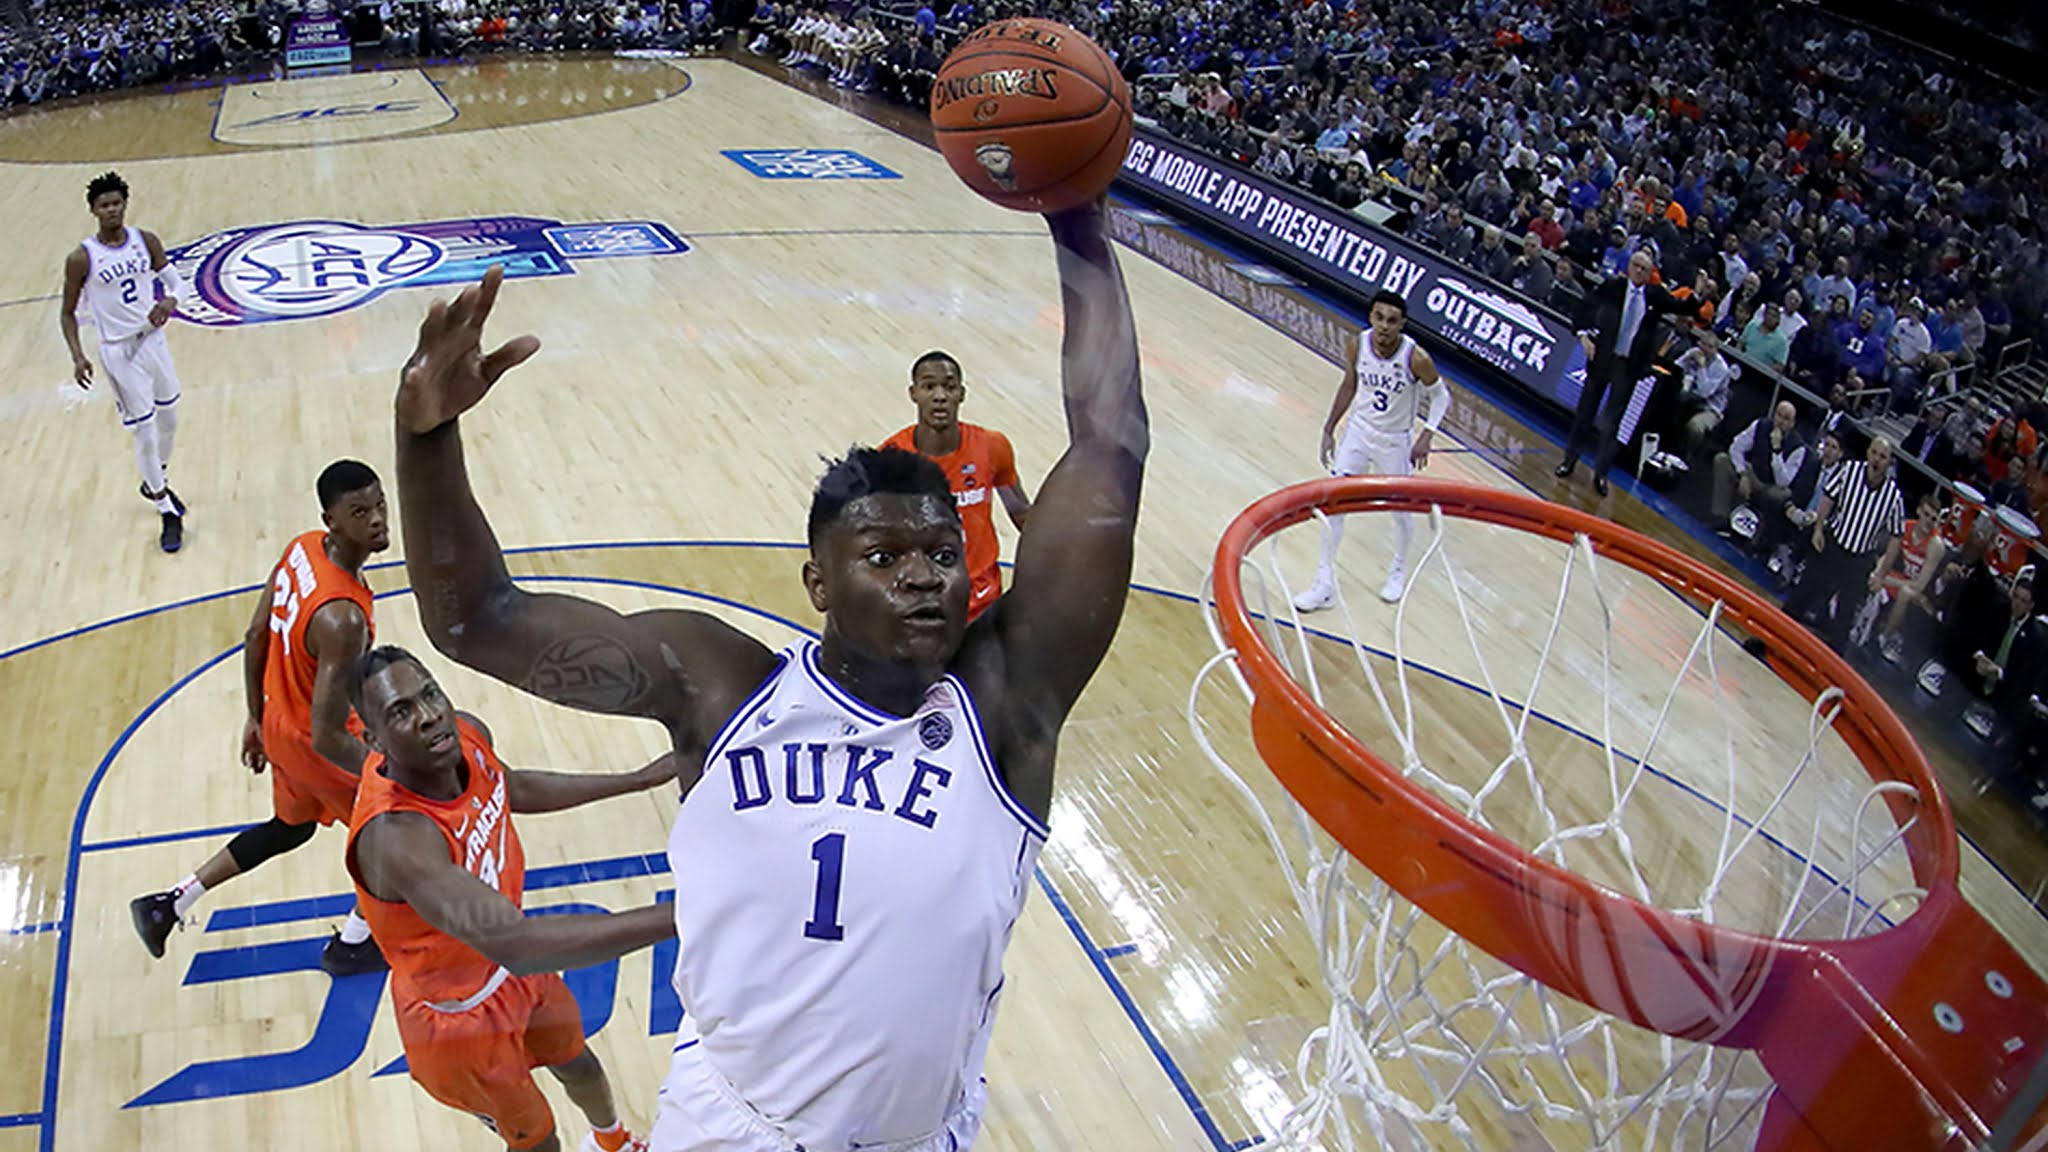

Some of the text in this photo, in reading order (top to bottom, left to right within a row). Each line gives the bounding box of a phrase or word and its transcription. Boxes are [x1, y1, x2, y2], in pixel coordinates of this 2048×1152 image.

[935, 67, 1059, 110] SPALDING
[1124, 138, 1427, 301] CC MOBILE APP PRESENTED BY
[99, 259, 148, 284] DUKE
[310, 241, 371, 288] ACC
[120, 278, 138, 304] 2
[1426, 286, 1551, 373] OUTBACK
[1360, 372, 1406, 394] DUKE
[1373, 390, 1388, 411] 3
[725, 742, 953, 829] DUKE
[803, 832, 846, 941] 1
